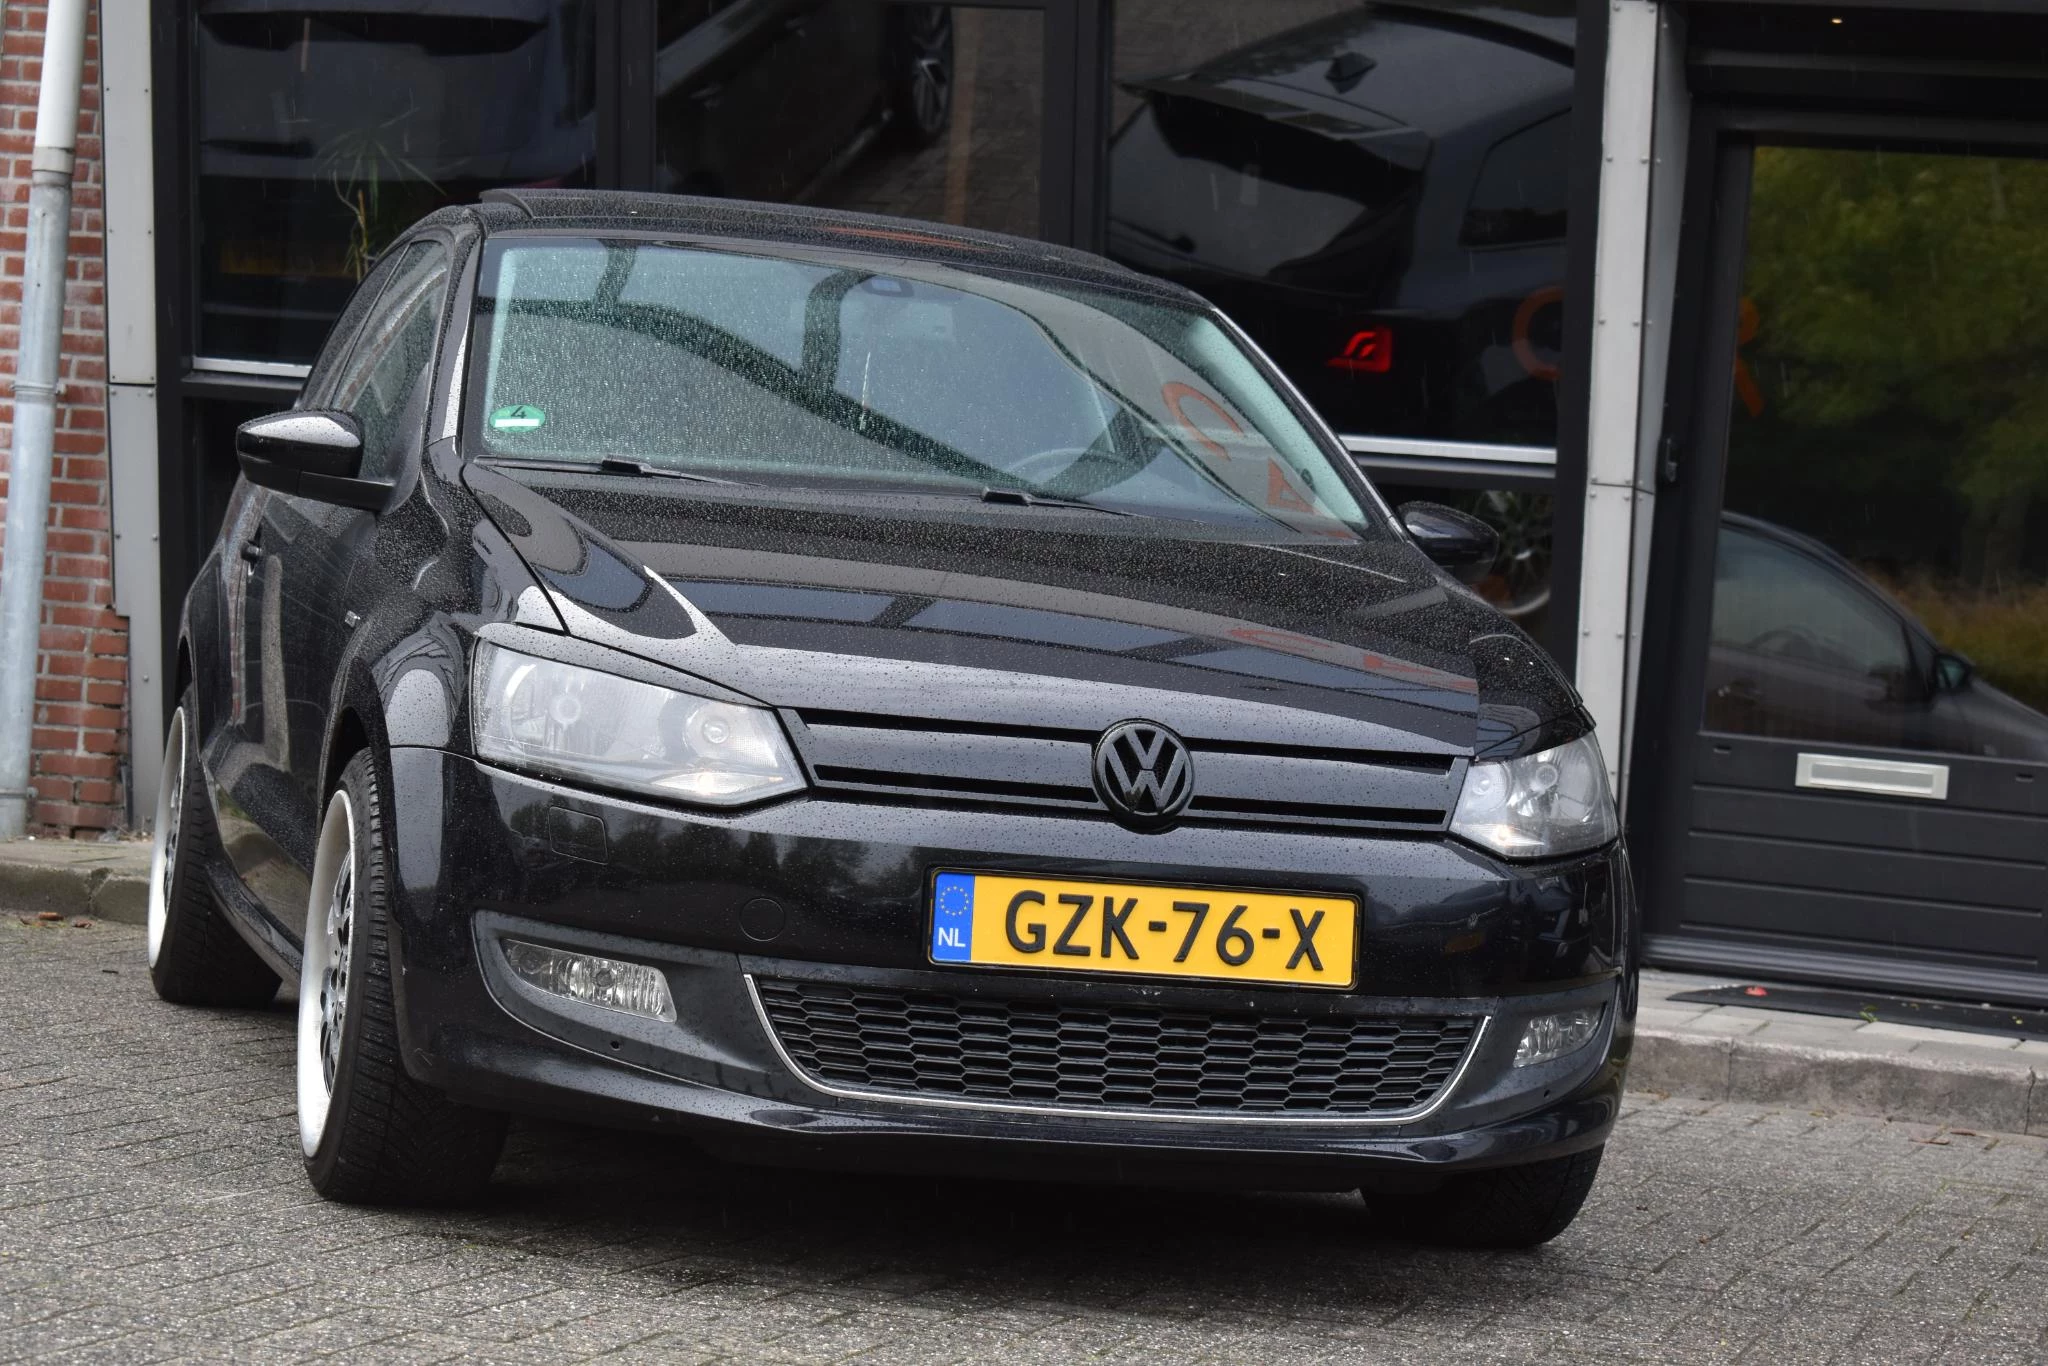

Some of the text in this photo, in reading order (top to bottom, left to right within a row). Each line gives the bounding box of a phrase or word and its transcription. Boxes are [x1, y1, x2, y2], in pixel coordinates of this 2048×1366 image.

[510, 405, 528, 419] 4
[937, 927, 967, 948] NL
[1005, 889, 1326, 972] GZK-76-X
